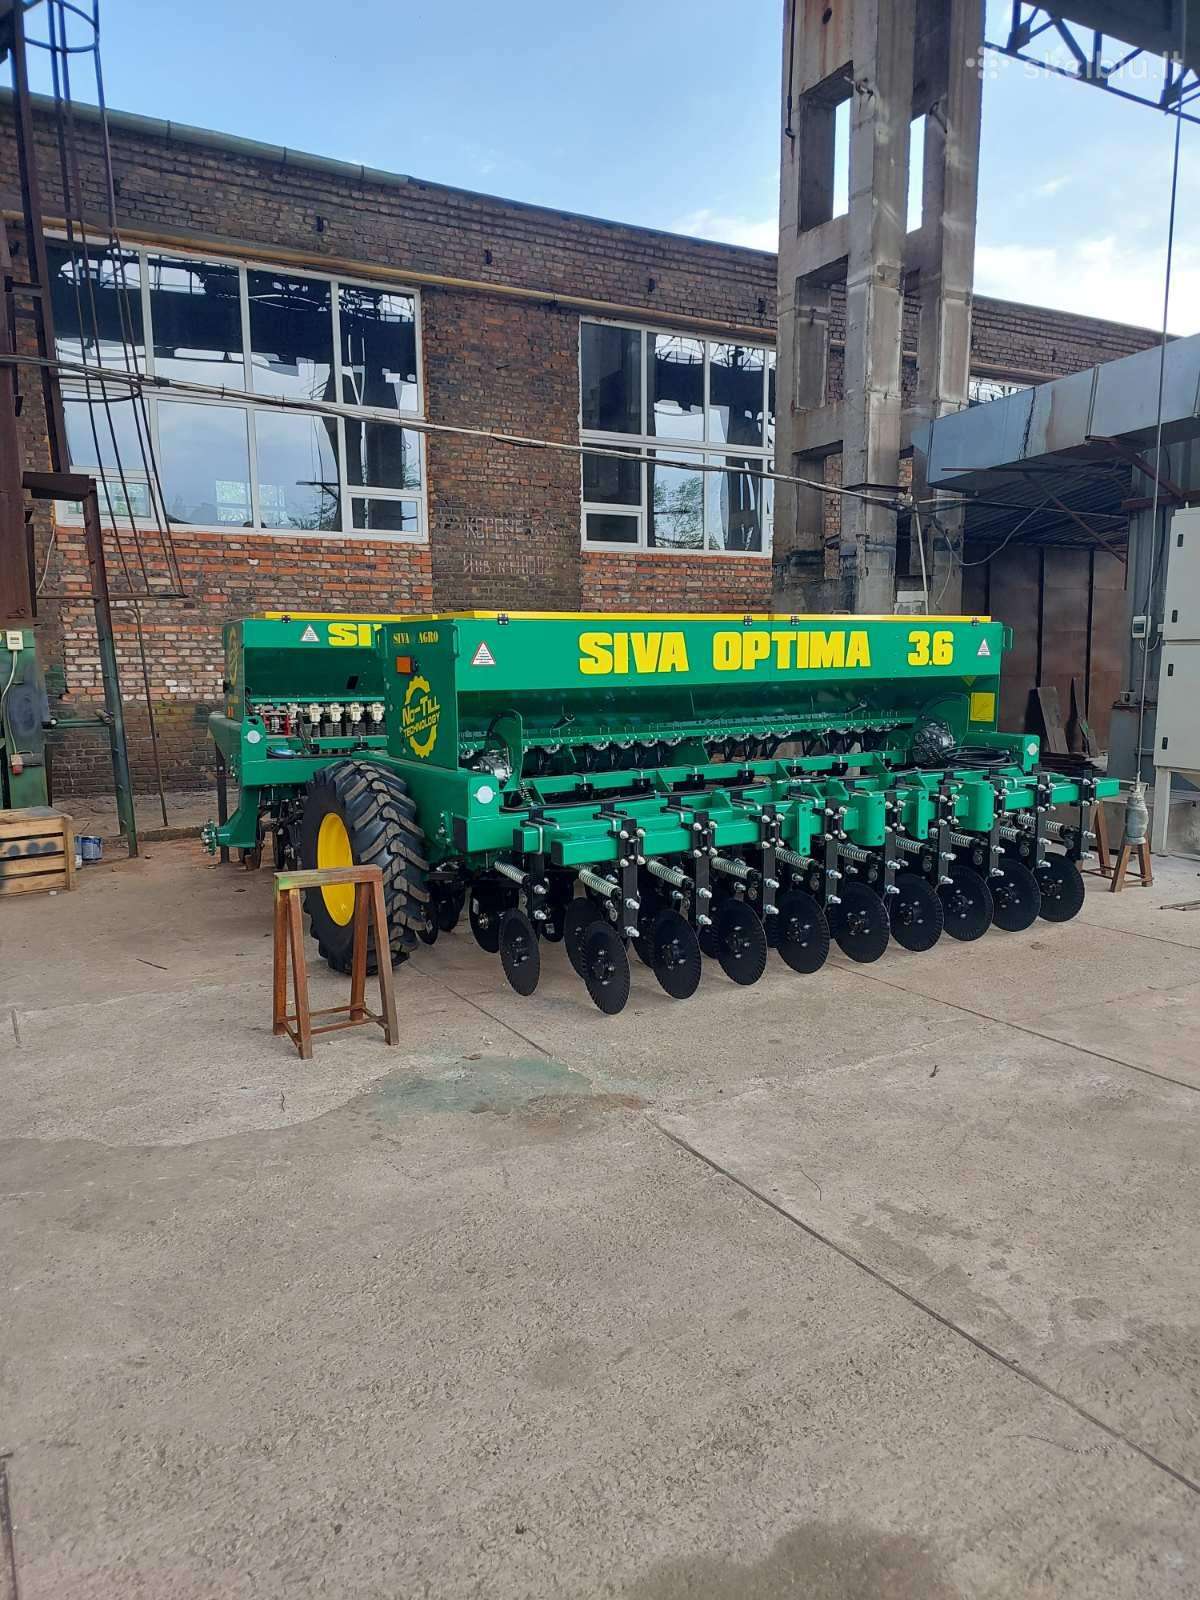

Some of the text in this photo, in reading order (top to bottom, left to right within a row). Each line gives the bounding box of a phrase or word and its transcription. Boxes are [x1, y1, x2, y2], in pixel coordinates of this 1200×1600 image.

[328, 623, 382, 646] SI
[393, 631, 439, 645] SIVA AGRO
[579, 630, 953, 674] SIVA OPTIMA 3.6
[403, 711, 440, 738] TECHNOLOGY
